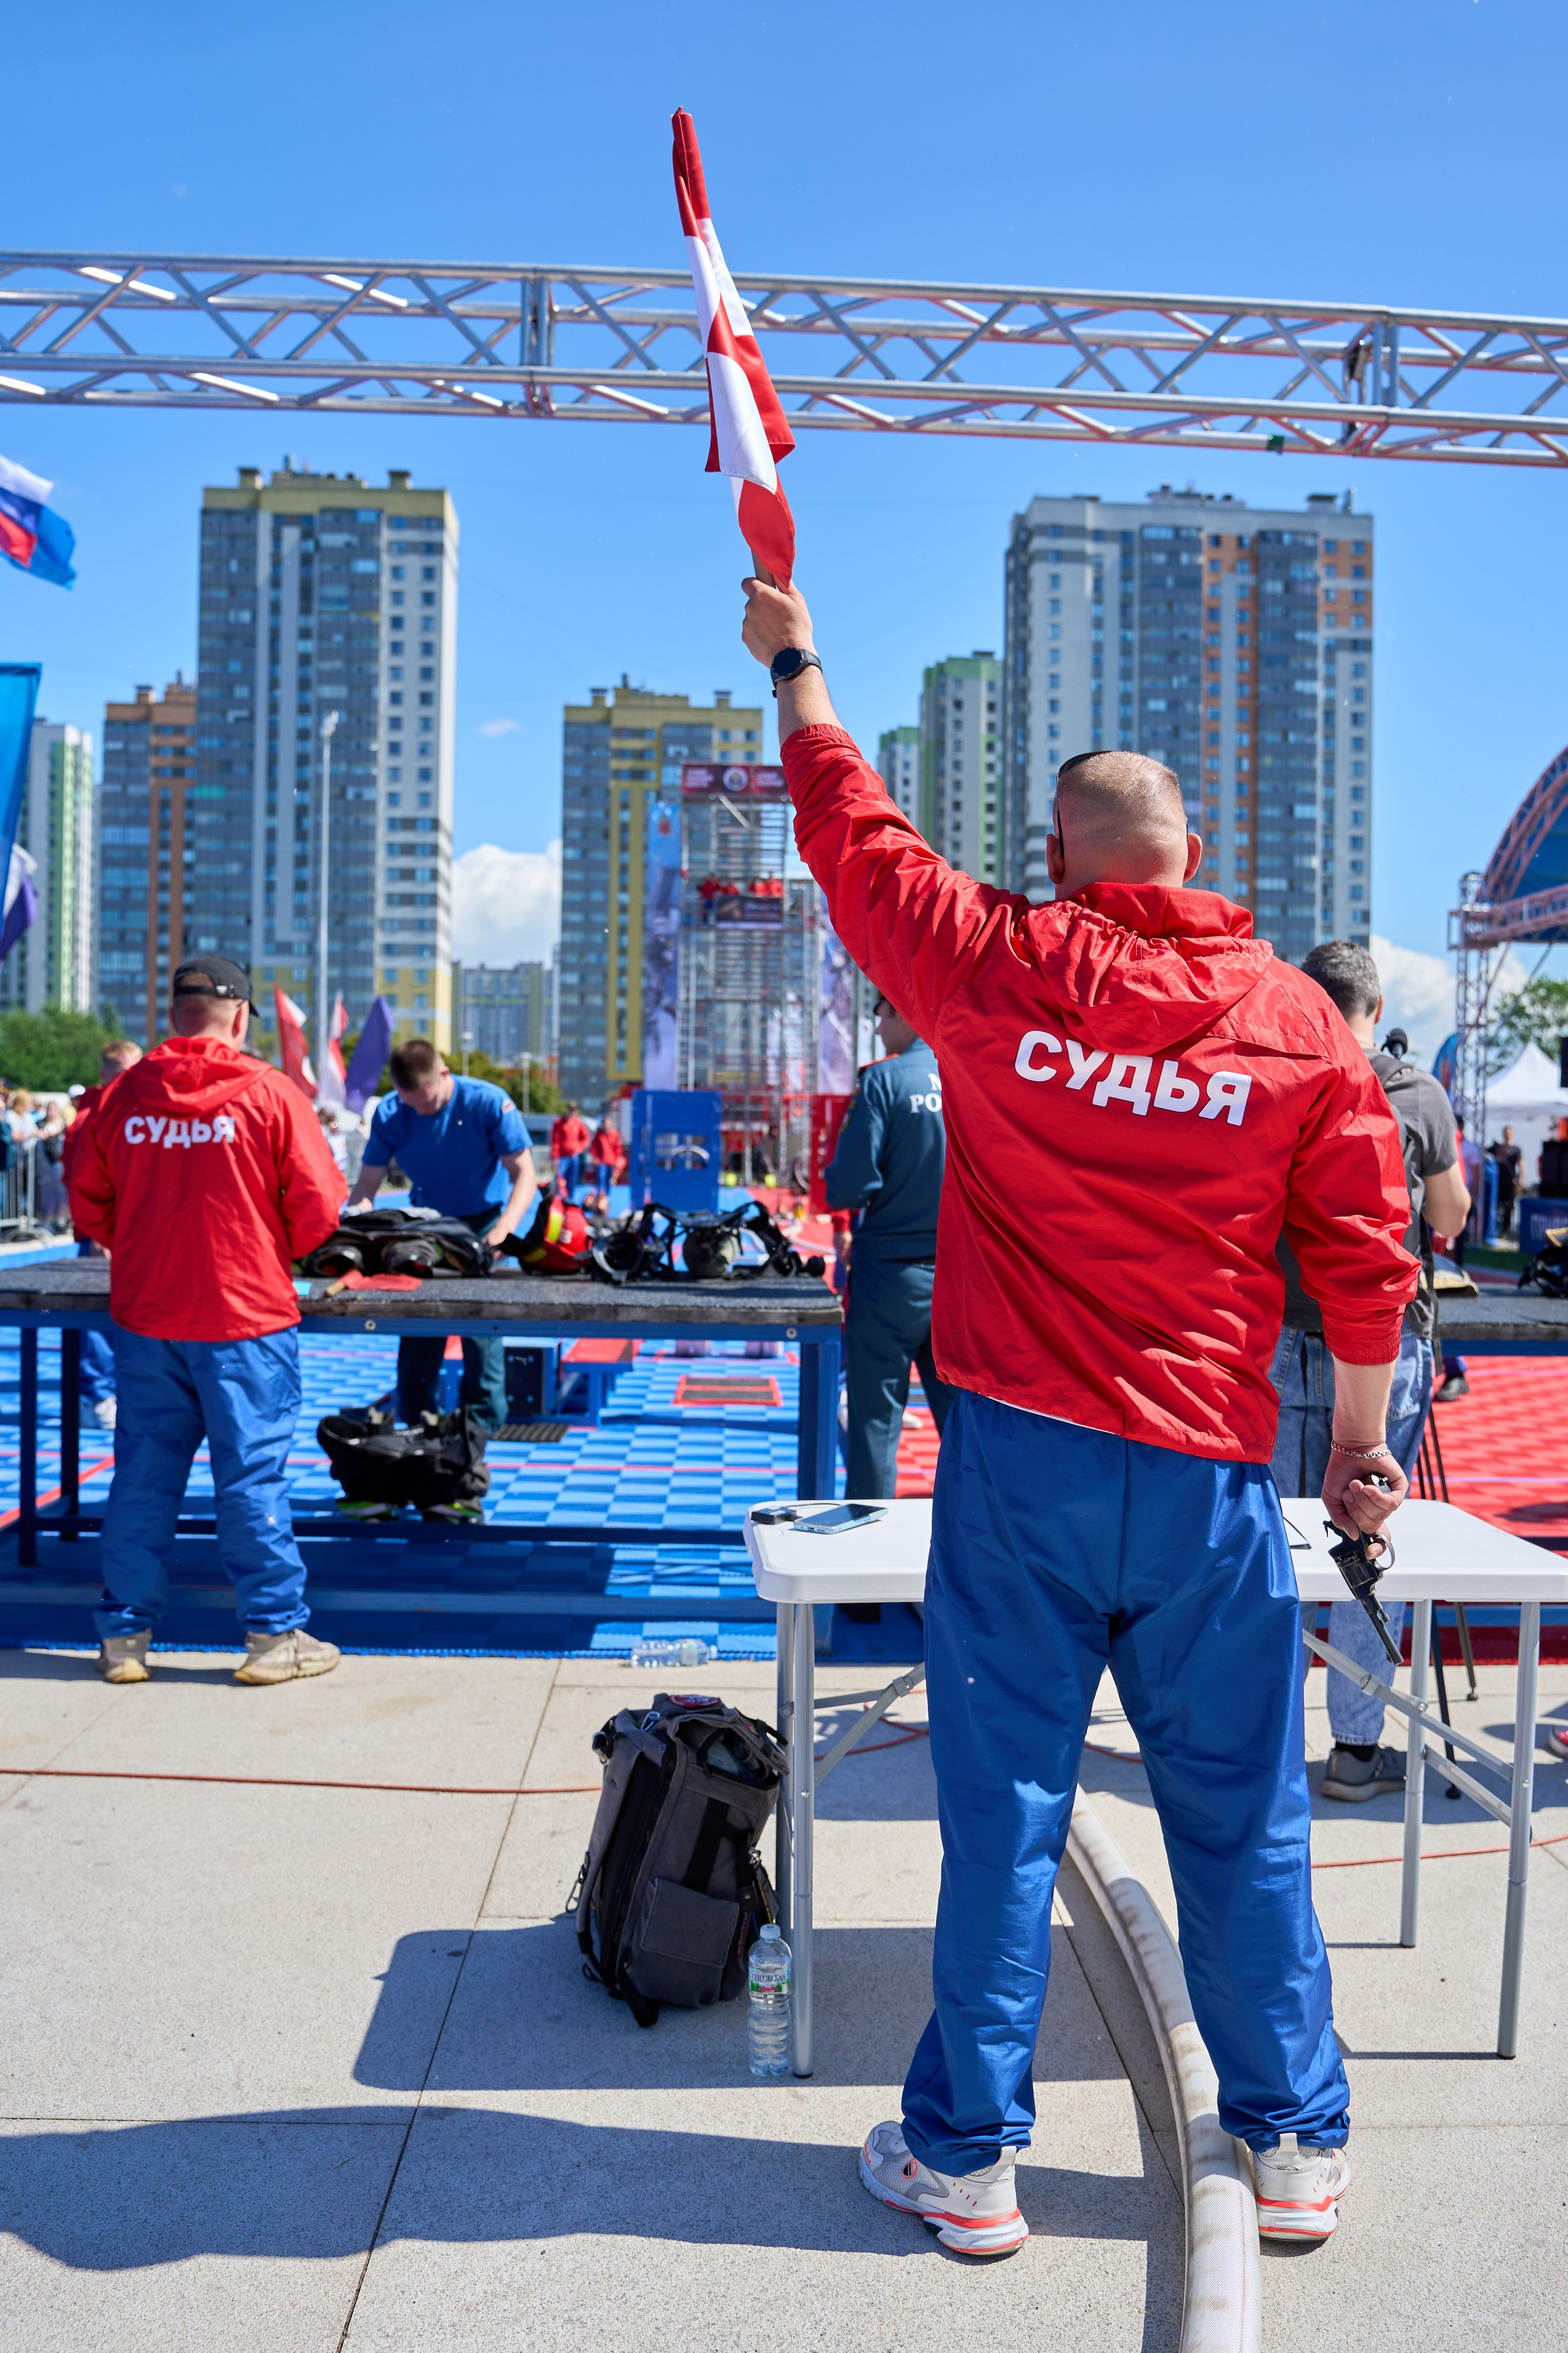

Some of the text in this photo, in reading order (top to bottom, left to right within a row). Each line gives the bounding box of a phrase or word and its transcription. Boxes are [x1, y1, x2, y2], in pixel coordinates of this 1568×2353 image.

[1014, 1030, 1252, 1126] СУДЬЯ
[124, 1115, 235, 1149] СУДЬЯ
[752, 1973, 786, 1982] СЕНЕЖСКАЯ
